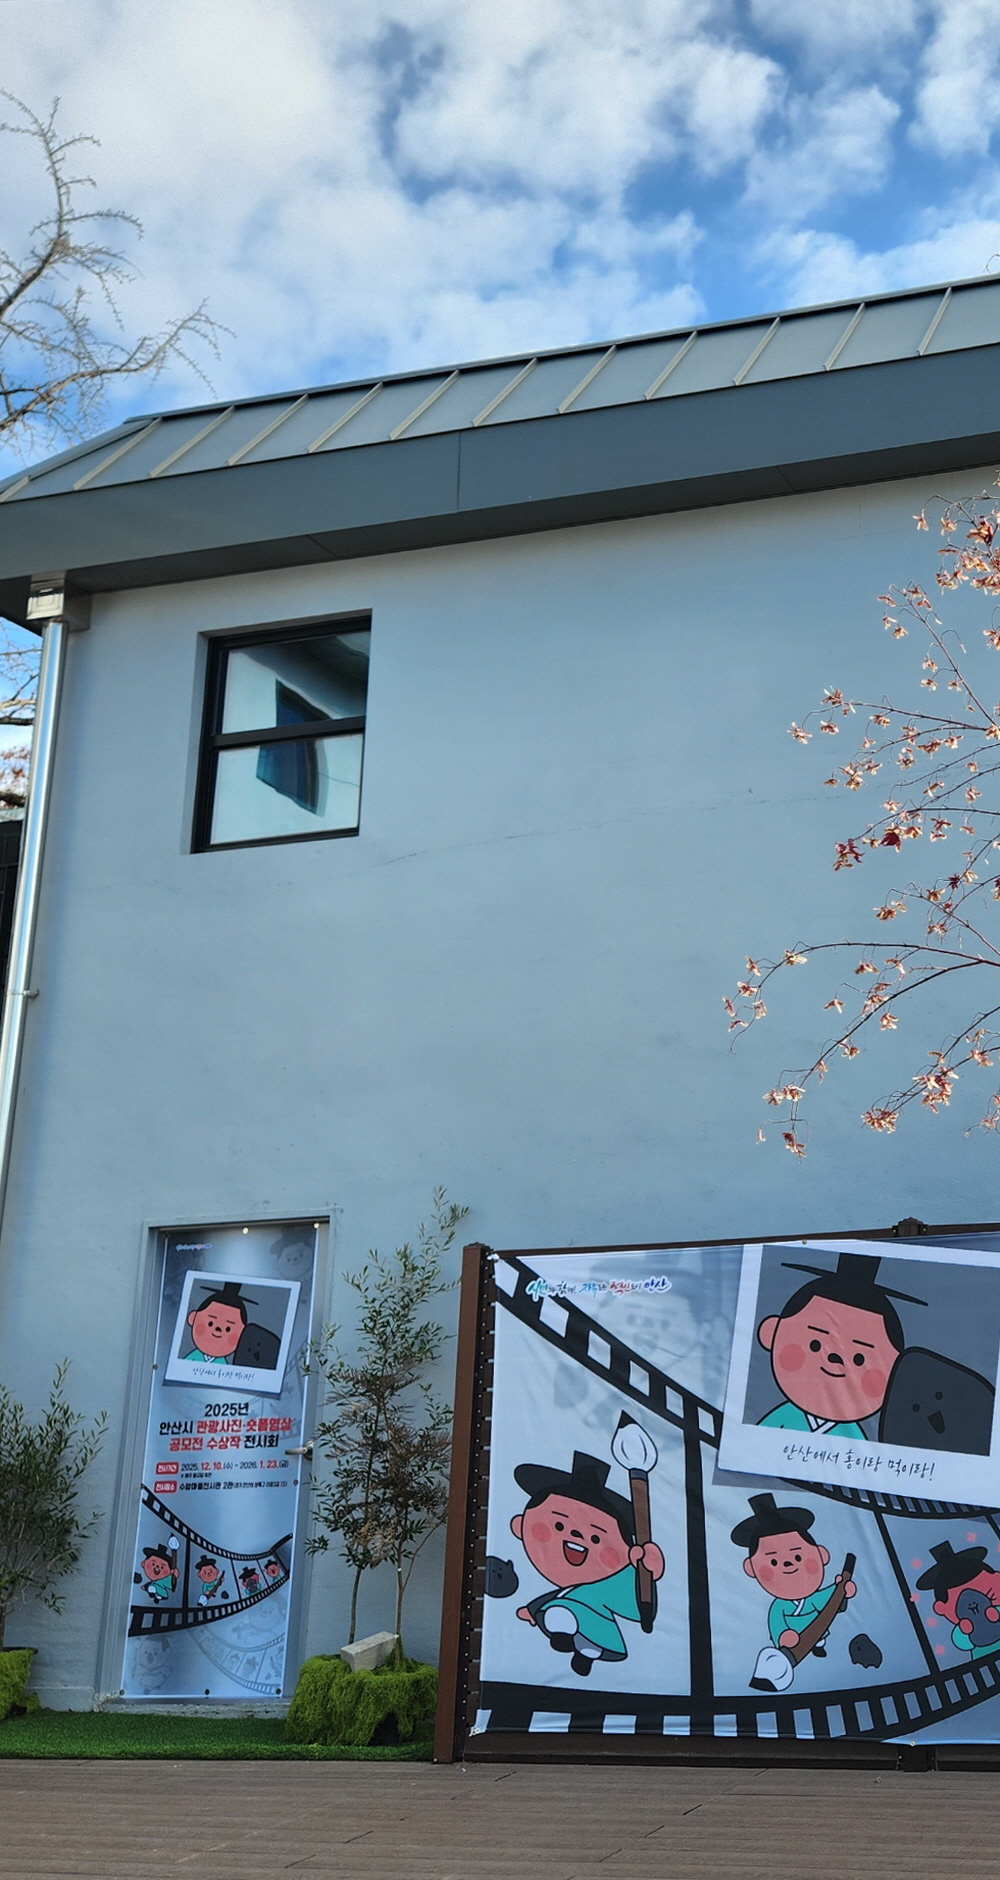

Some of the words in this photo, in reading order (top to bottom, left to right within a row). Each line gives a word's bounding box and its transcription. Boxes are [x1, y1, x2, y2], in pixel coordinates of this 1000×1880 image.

[644, 1278, 671, 1292] 안산
[204, 1402, 249, 1417] 2025년
[159, 1421, 193, 1435] 안산시
[169, 1437, 203, 1451] 공모전
[206, 1435, 241, 1450] 수상작
[244, 1434, 279, 1448] 전시회
[783, 1444, 840, 1465] 안산에서
[844, 1449, 883, 1472] 홍이랑
[888, 1458, 936, 1481] 먹이랑!
